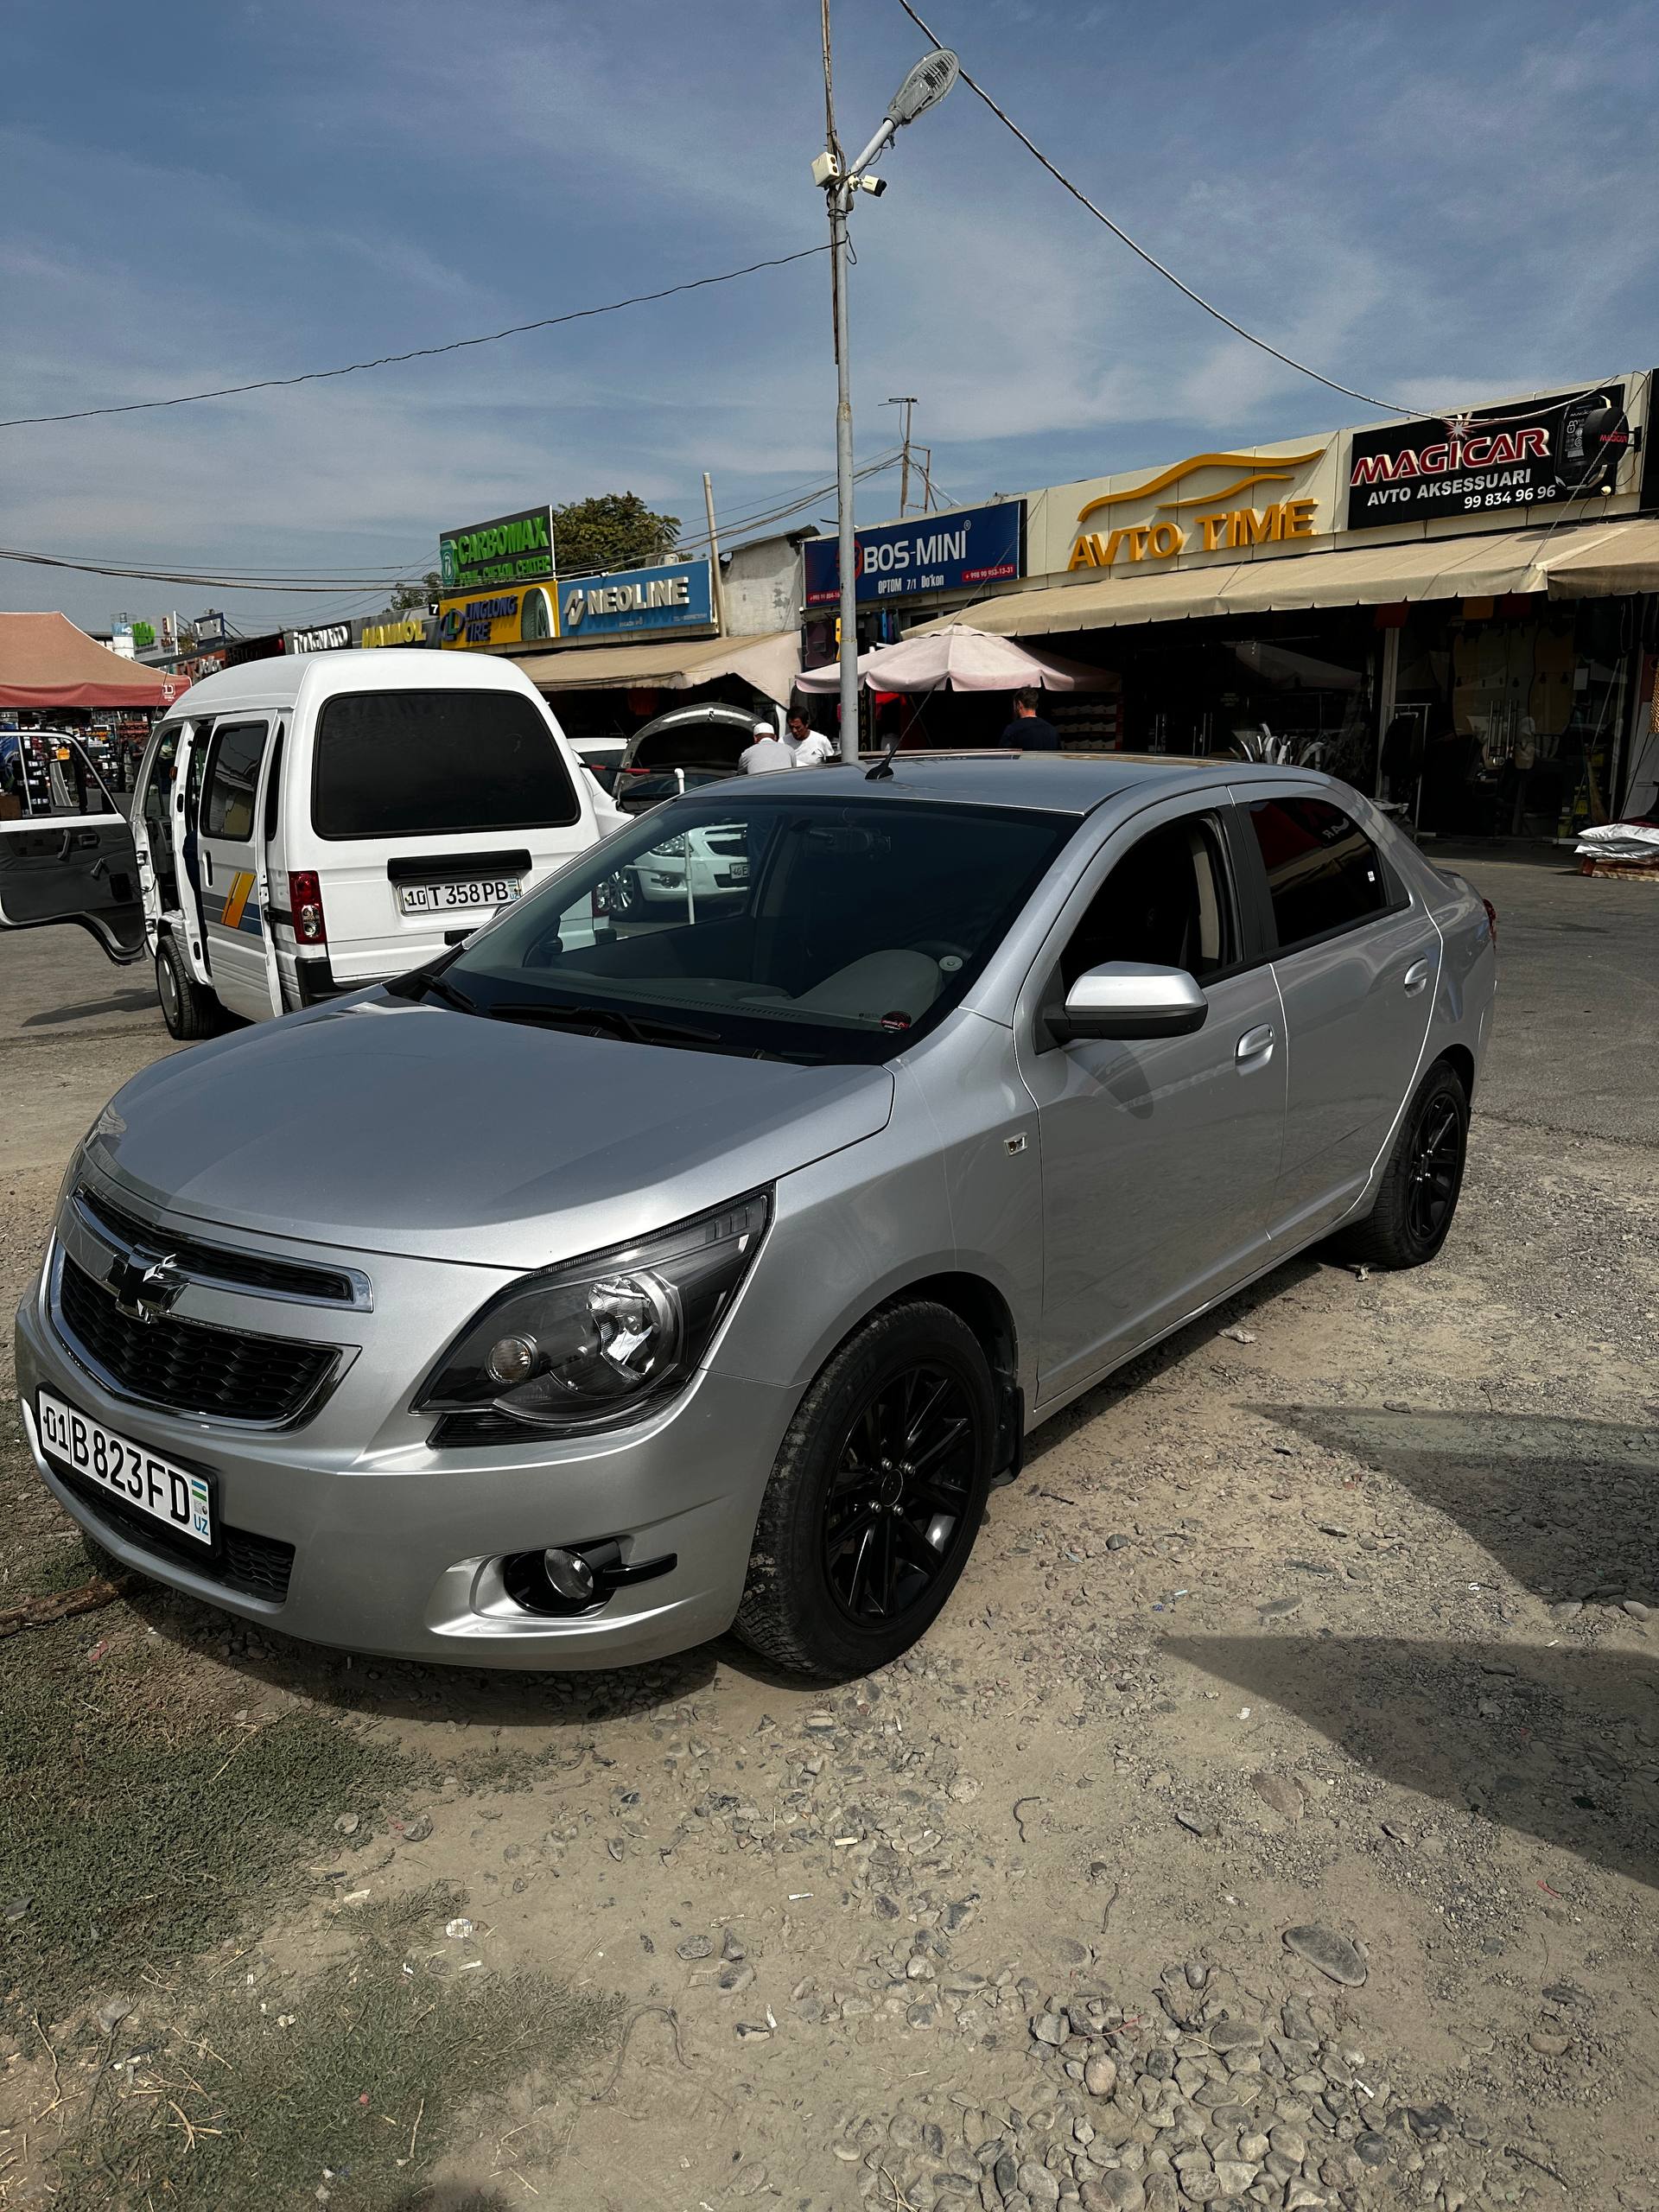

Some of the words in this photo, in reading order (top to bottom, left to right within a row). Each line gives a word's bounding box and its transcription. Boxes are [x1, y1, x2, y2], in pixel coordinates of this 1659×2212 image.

[1350, 428, 1552, 486] MAGICAR
[1368, 486, 1411, 506] AVTO
[1417, 468, 1531, 499] AKSESSUARI
[1464, 494, 1481, 510] 99
[1484, 492, 1511, 507] 834
[1516, 488, 1534, 503] 96
[1537, 485, 1556, 499] 96
[458, 516, 550, 564] CARBOMAX
[1068, 521, 1183, 571] AVTO
[1195, 498, 1319, 550] TIME
[863, 530, 967, 575] BOS-MINI
[588, 576, 690, 614] NEOLINE
[878, 577, 902, 594] OPTOM
[431, 604, 438, 614] 7
[466, 595, 518, 621] LINGLONG
[465, 621, 491, 642] TIRE
[408, 890, 426, 906] 10
[43, 1405, 68, 1452] 01
[194, 1514, 209, 1536] UZ
